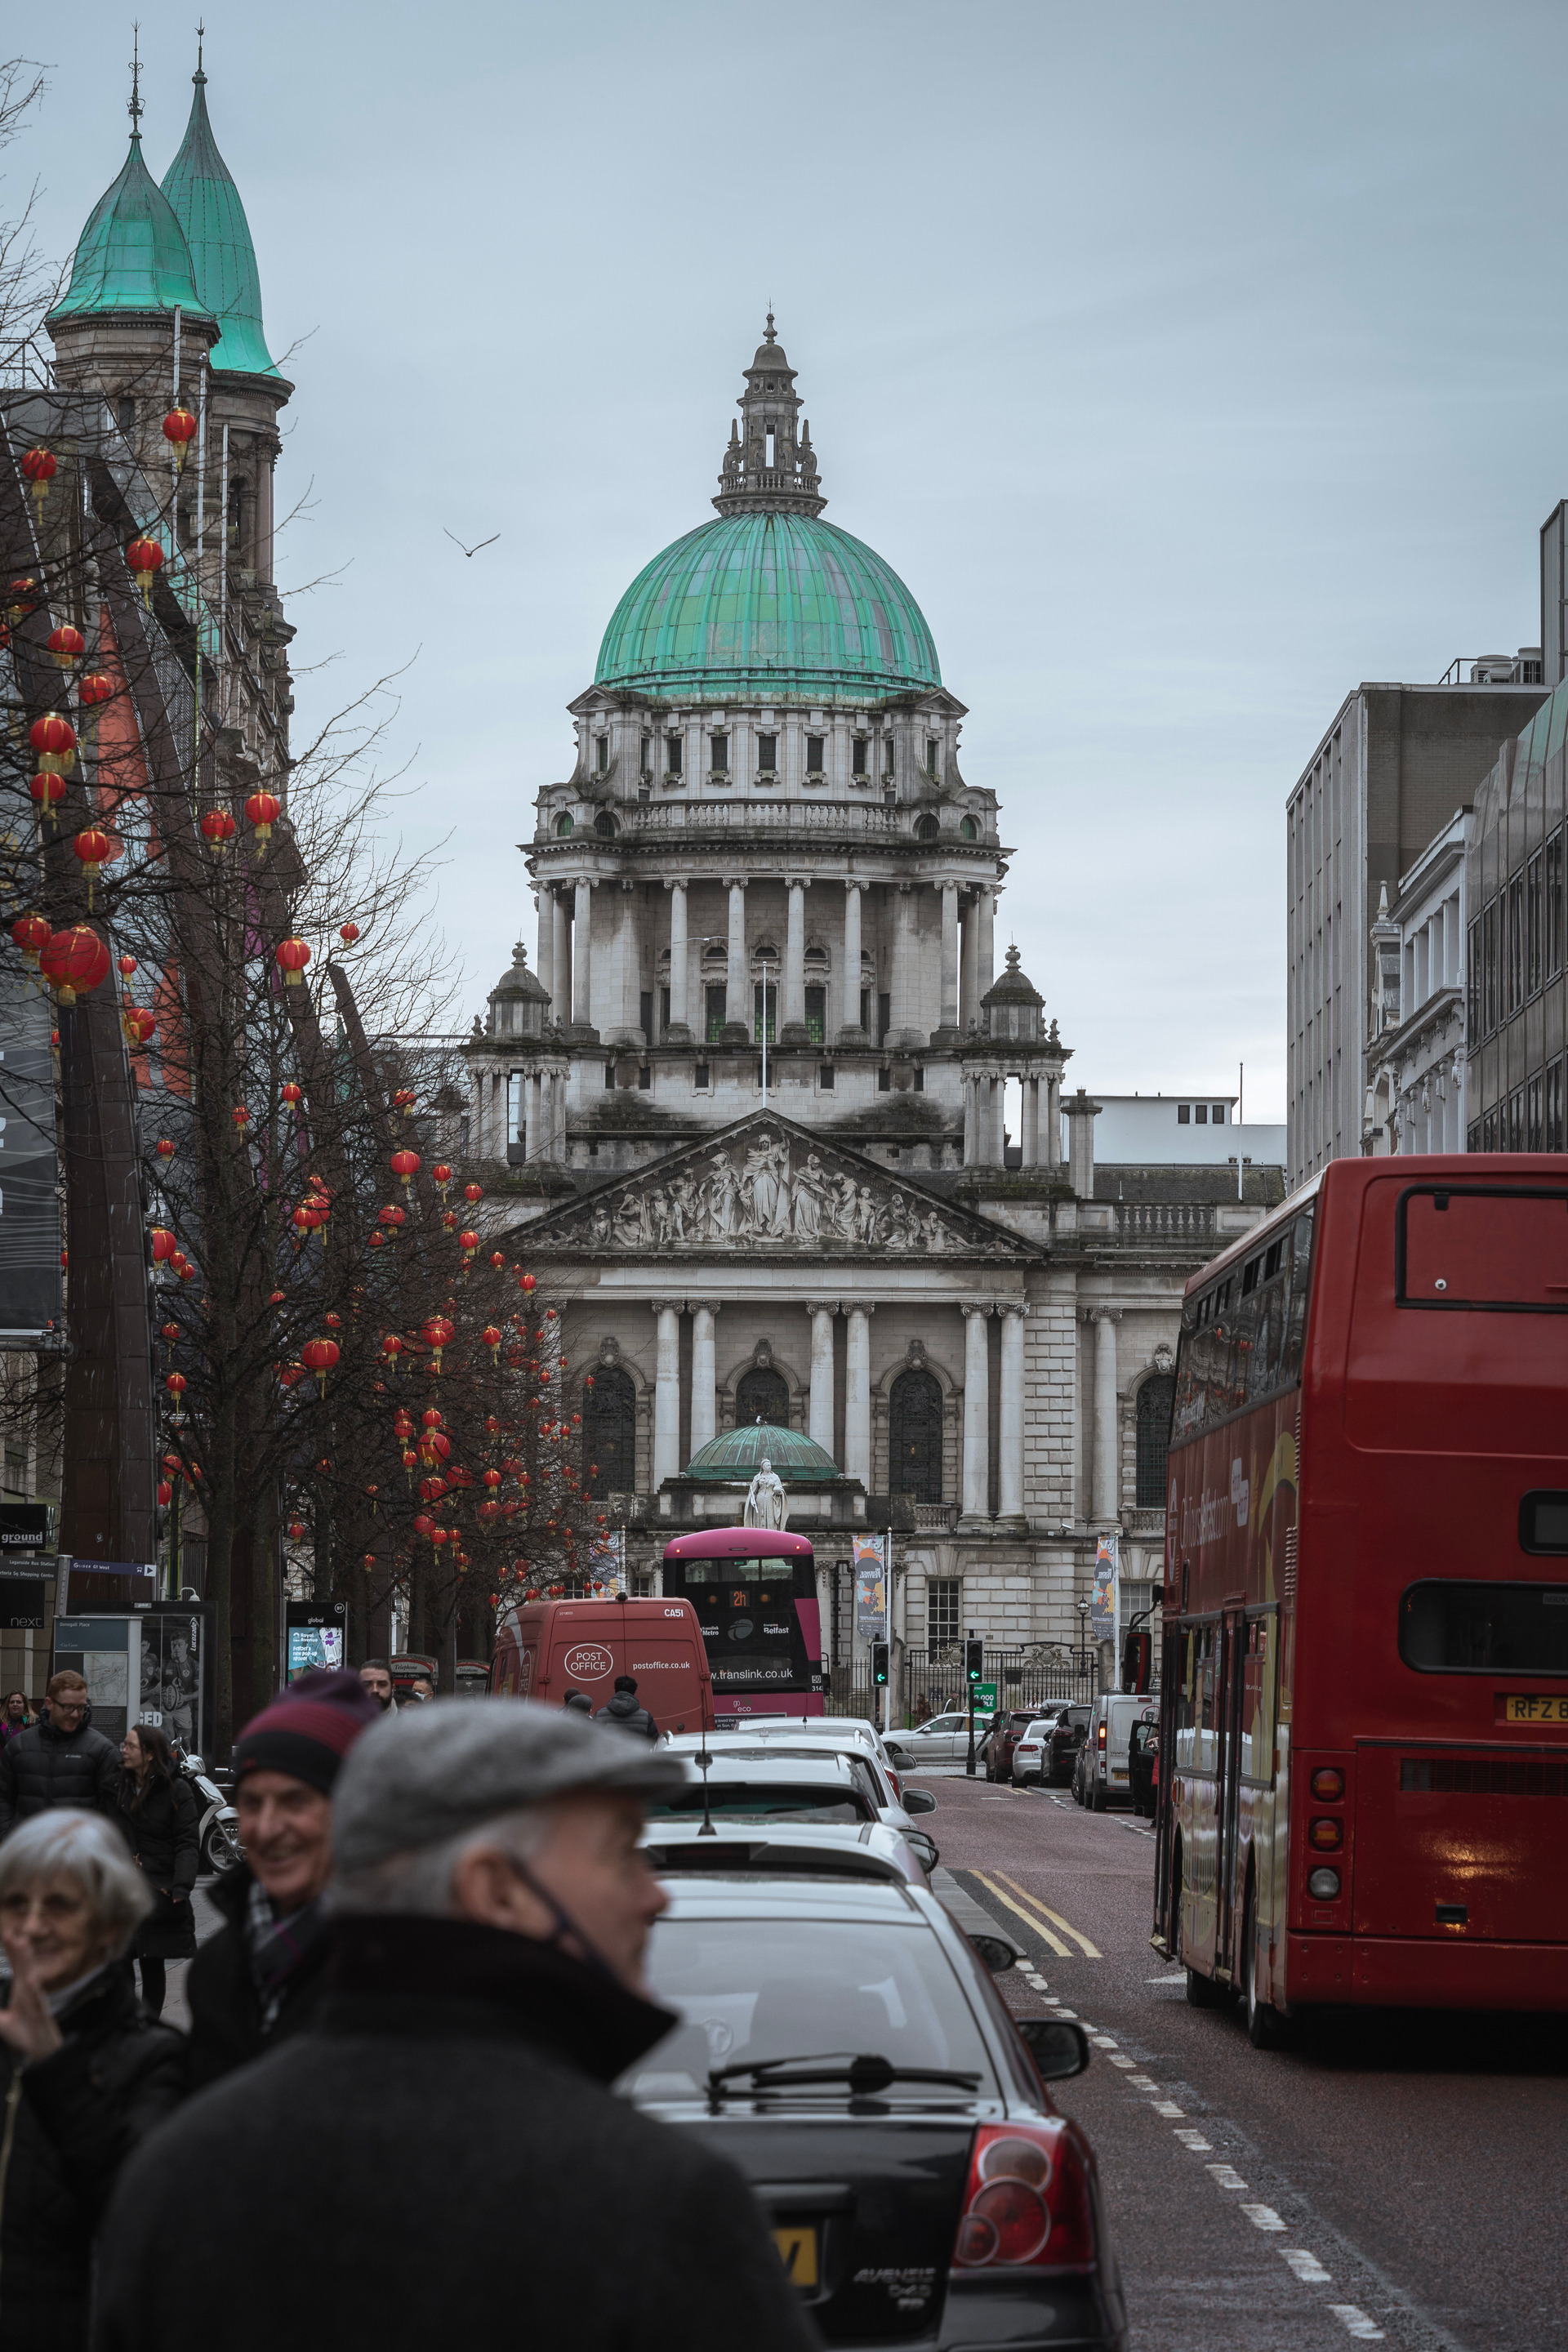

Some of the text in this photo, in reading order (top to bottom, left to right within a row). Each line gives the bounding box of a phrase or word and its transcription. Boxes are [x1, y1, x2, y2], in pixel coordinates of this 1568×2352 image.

[1, 1531, 42, 1544] ground
[11, 1617, 42, 1628] next
[576, 1652, 603, 1661] POST
[570, 1661, 607, 1671] OFFICE
[632, 1661, 691, 1671] postoffice.co.uk
[1515, 1700, 1552, 1718] RFZ
